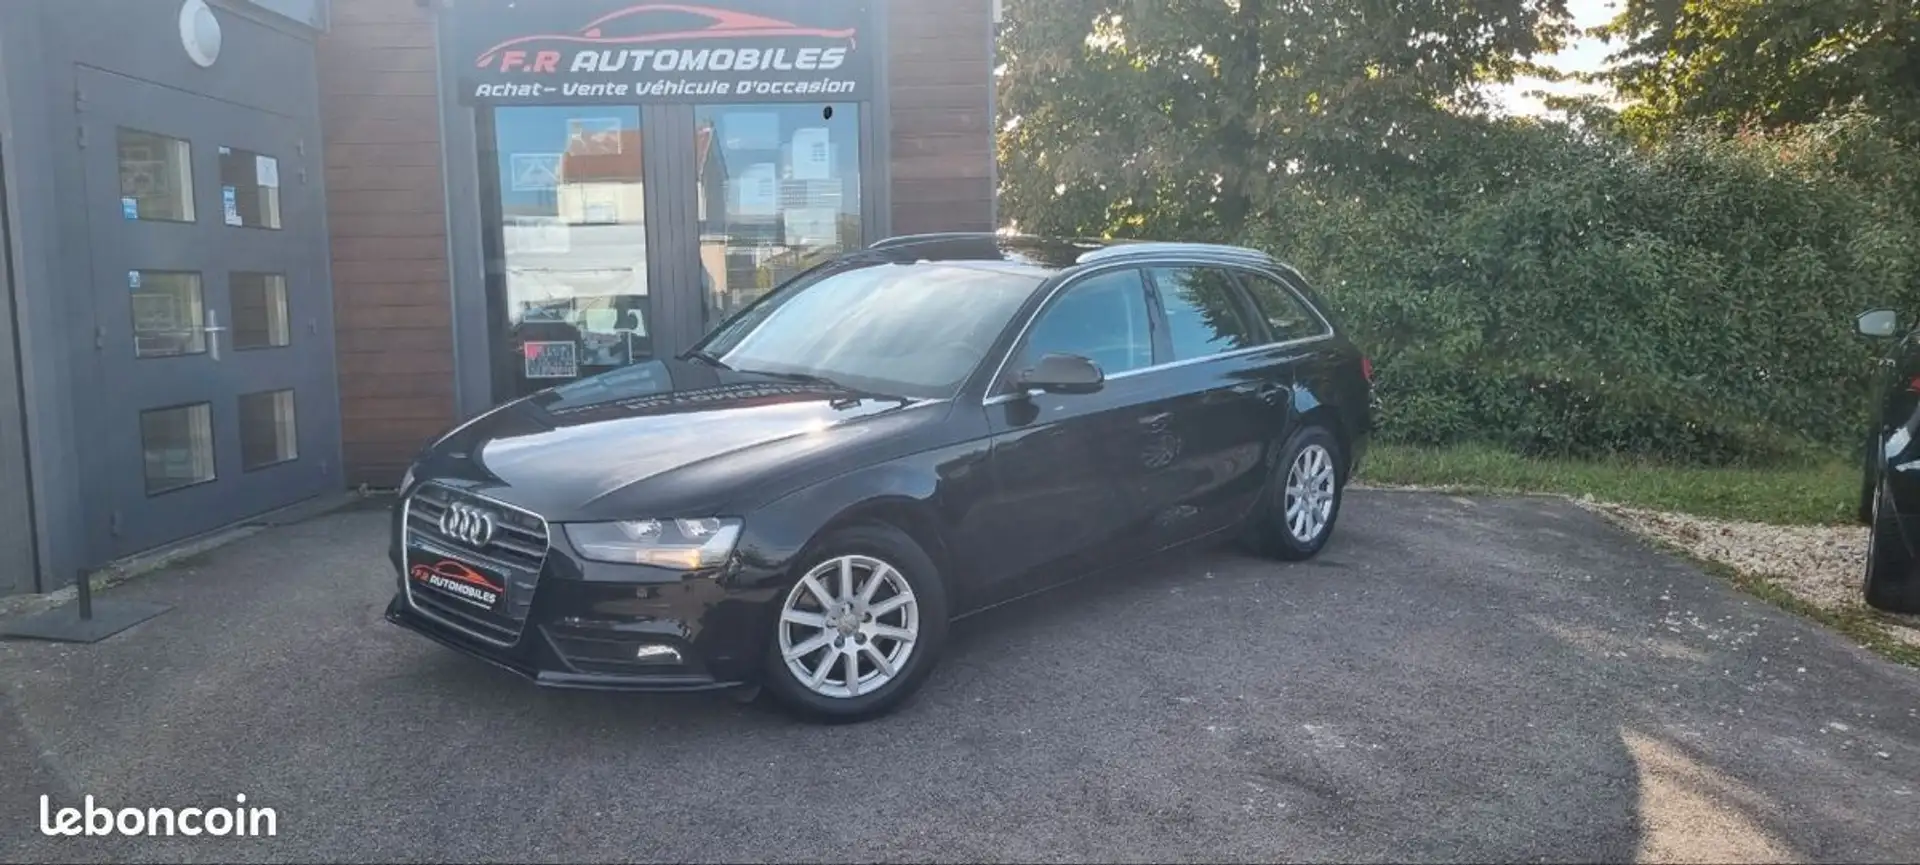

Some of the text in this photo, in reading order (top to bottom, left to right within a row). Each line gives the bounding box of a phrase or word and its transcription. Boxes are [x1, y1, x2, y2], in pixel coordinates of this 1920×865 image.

[500, 46, 847, 73] F.R AUTOMOBILES
[562, 82, 628, 97] Vente
[635, 79, 730, 96] Véhicule
[735, 77, 855, 95] D'occasion
[430, 574, 496, 604] AUTOMOBILES
